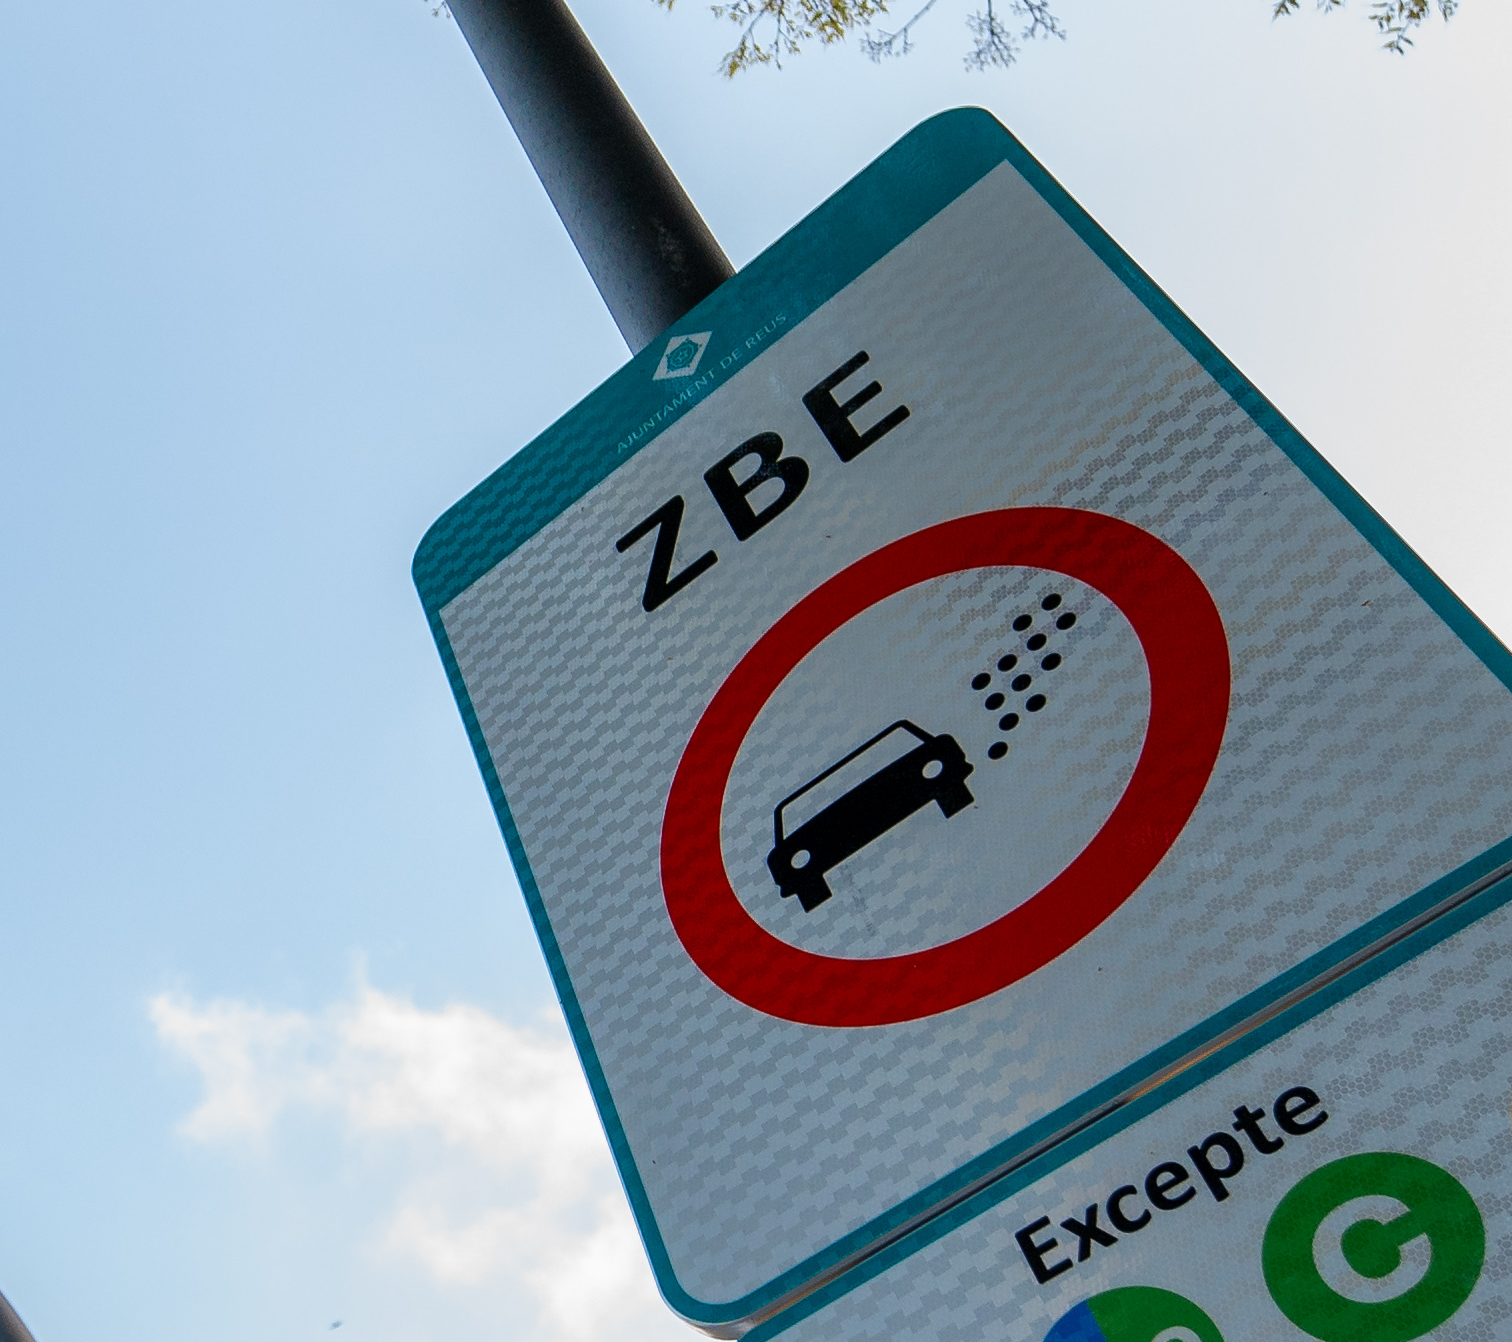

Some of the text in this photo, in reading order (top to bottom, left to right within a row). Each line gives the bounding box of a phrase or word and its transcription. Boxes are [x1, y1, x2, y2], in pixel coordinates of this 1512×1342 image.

[616, 311, 786, 454] AJUNTAMENT DE REUS
[616, 349, 911, 613] ZBE
[1014, 1084, 1329, 1285] Excepte
[1311, 1194, 1433, 1305] C
